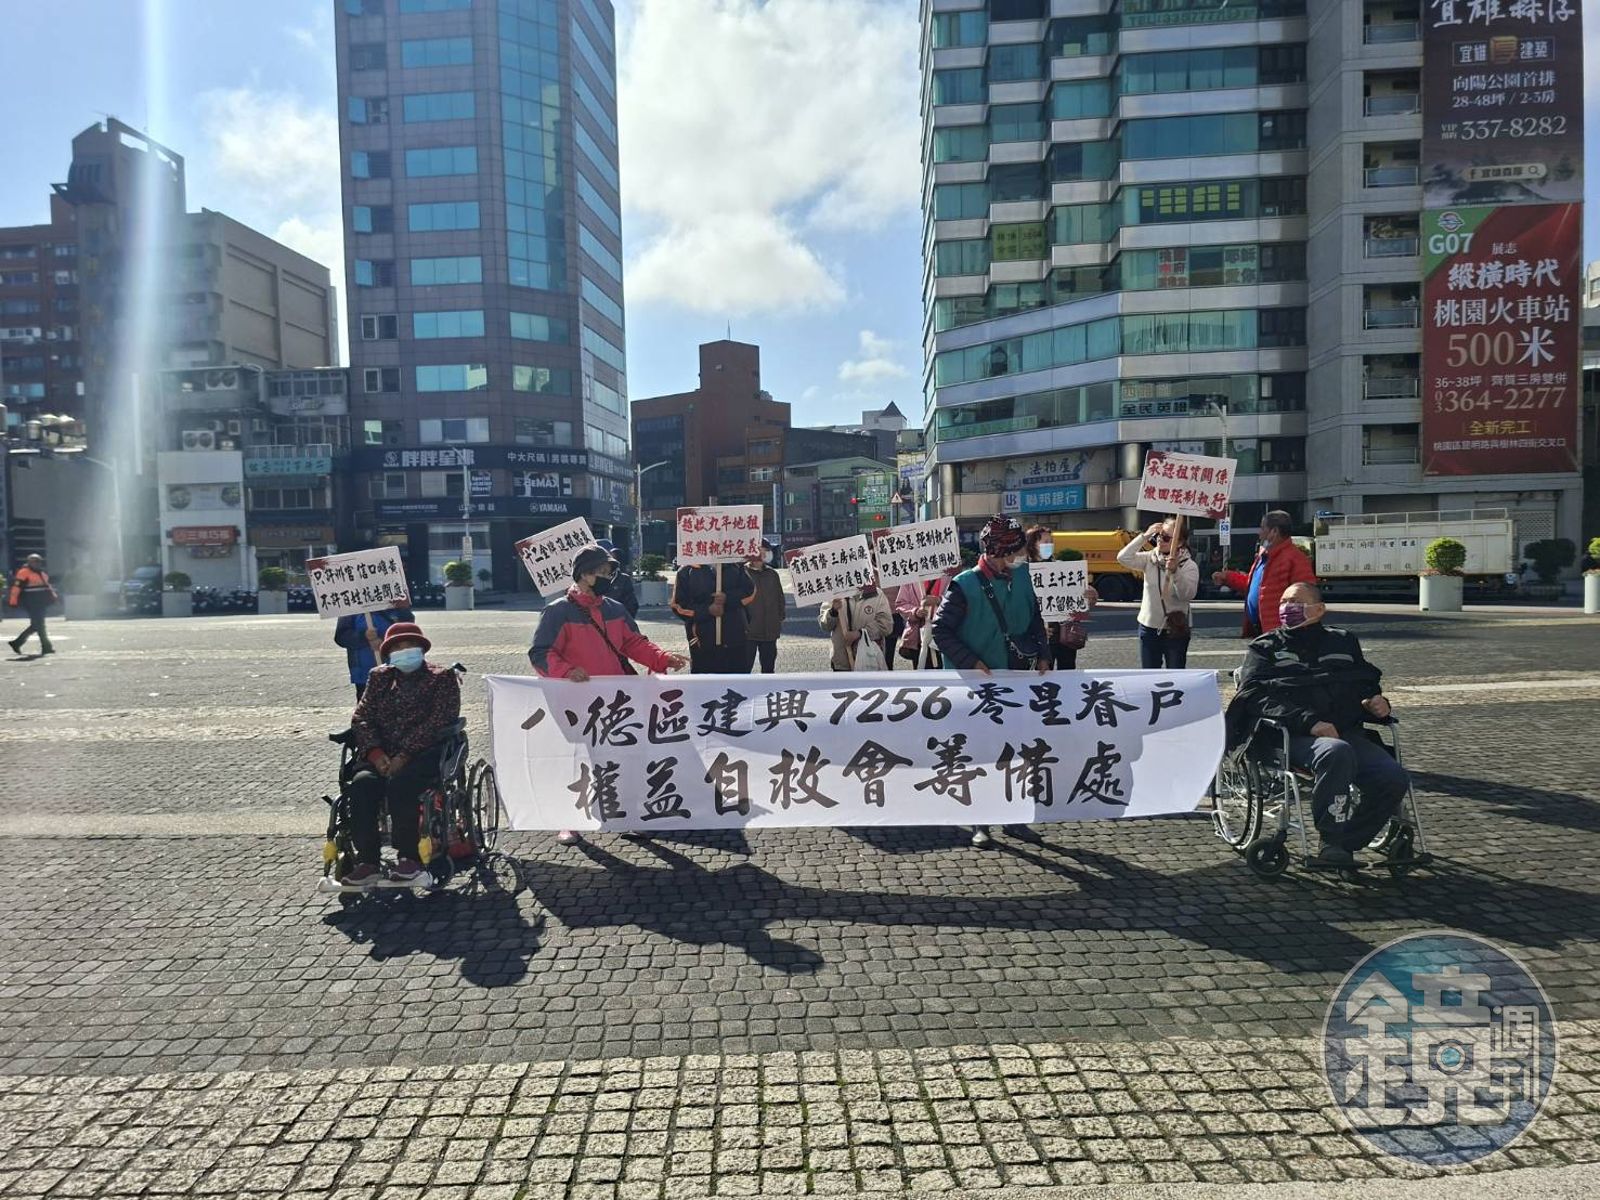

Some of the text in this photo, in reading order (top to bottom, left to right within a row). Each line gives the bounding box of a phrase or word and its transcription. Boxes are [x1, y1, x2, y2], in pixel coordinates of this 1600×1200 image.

[1453, 70, 1556, 91] 向陽公園首排
[1461, 116, 1566, 140] 337-8282
[1428, 233, 1474, 254] G07
[1447, 259, 1561, 290] 縱橫時代
[1433, 295, 1569, 328] 桃園火車站
[1447, 326, 1555, 367] 500米
[1122, 402, 1187, 415] 全民英檢
[1444, 387, 1566, 412] 364-2277
[1469, 420, 1531, 436] 全新完工
[1029, 458, 1072, 475] 法拍屋
[540, 504, 567, 512] YAMAHA
[1025, 490, 1078, 506] 聯邦銀行
[1144, 485, 1226, 510] 撤回強制執行
[521, 681, 1184, 747] 八德區建興7256零星眷戶
[567, 733, 1130, 822] 權益自救會籌備處
